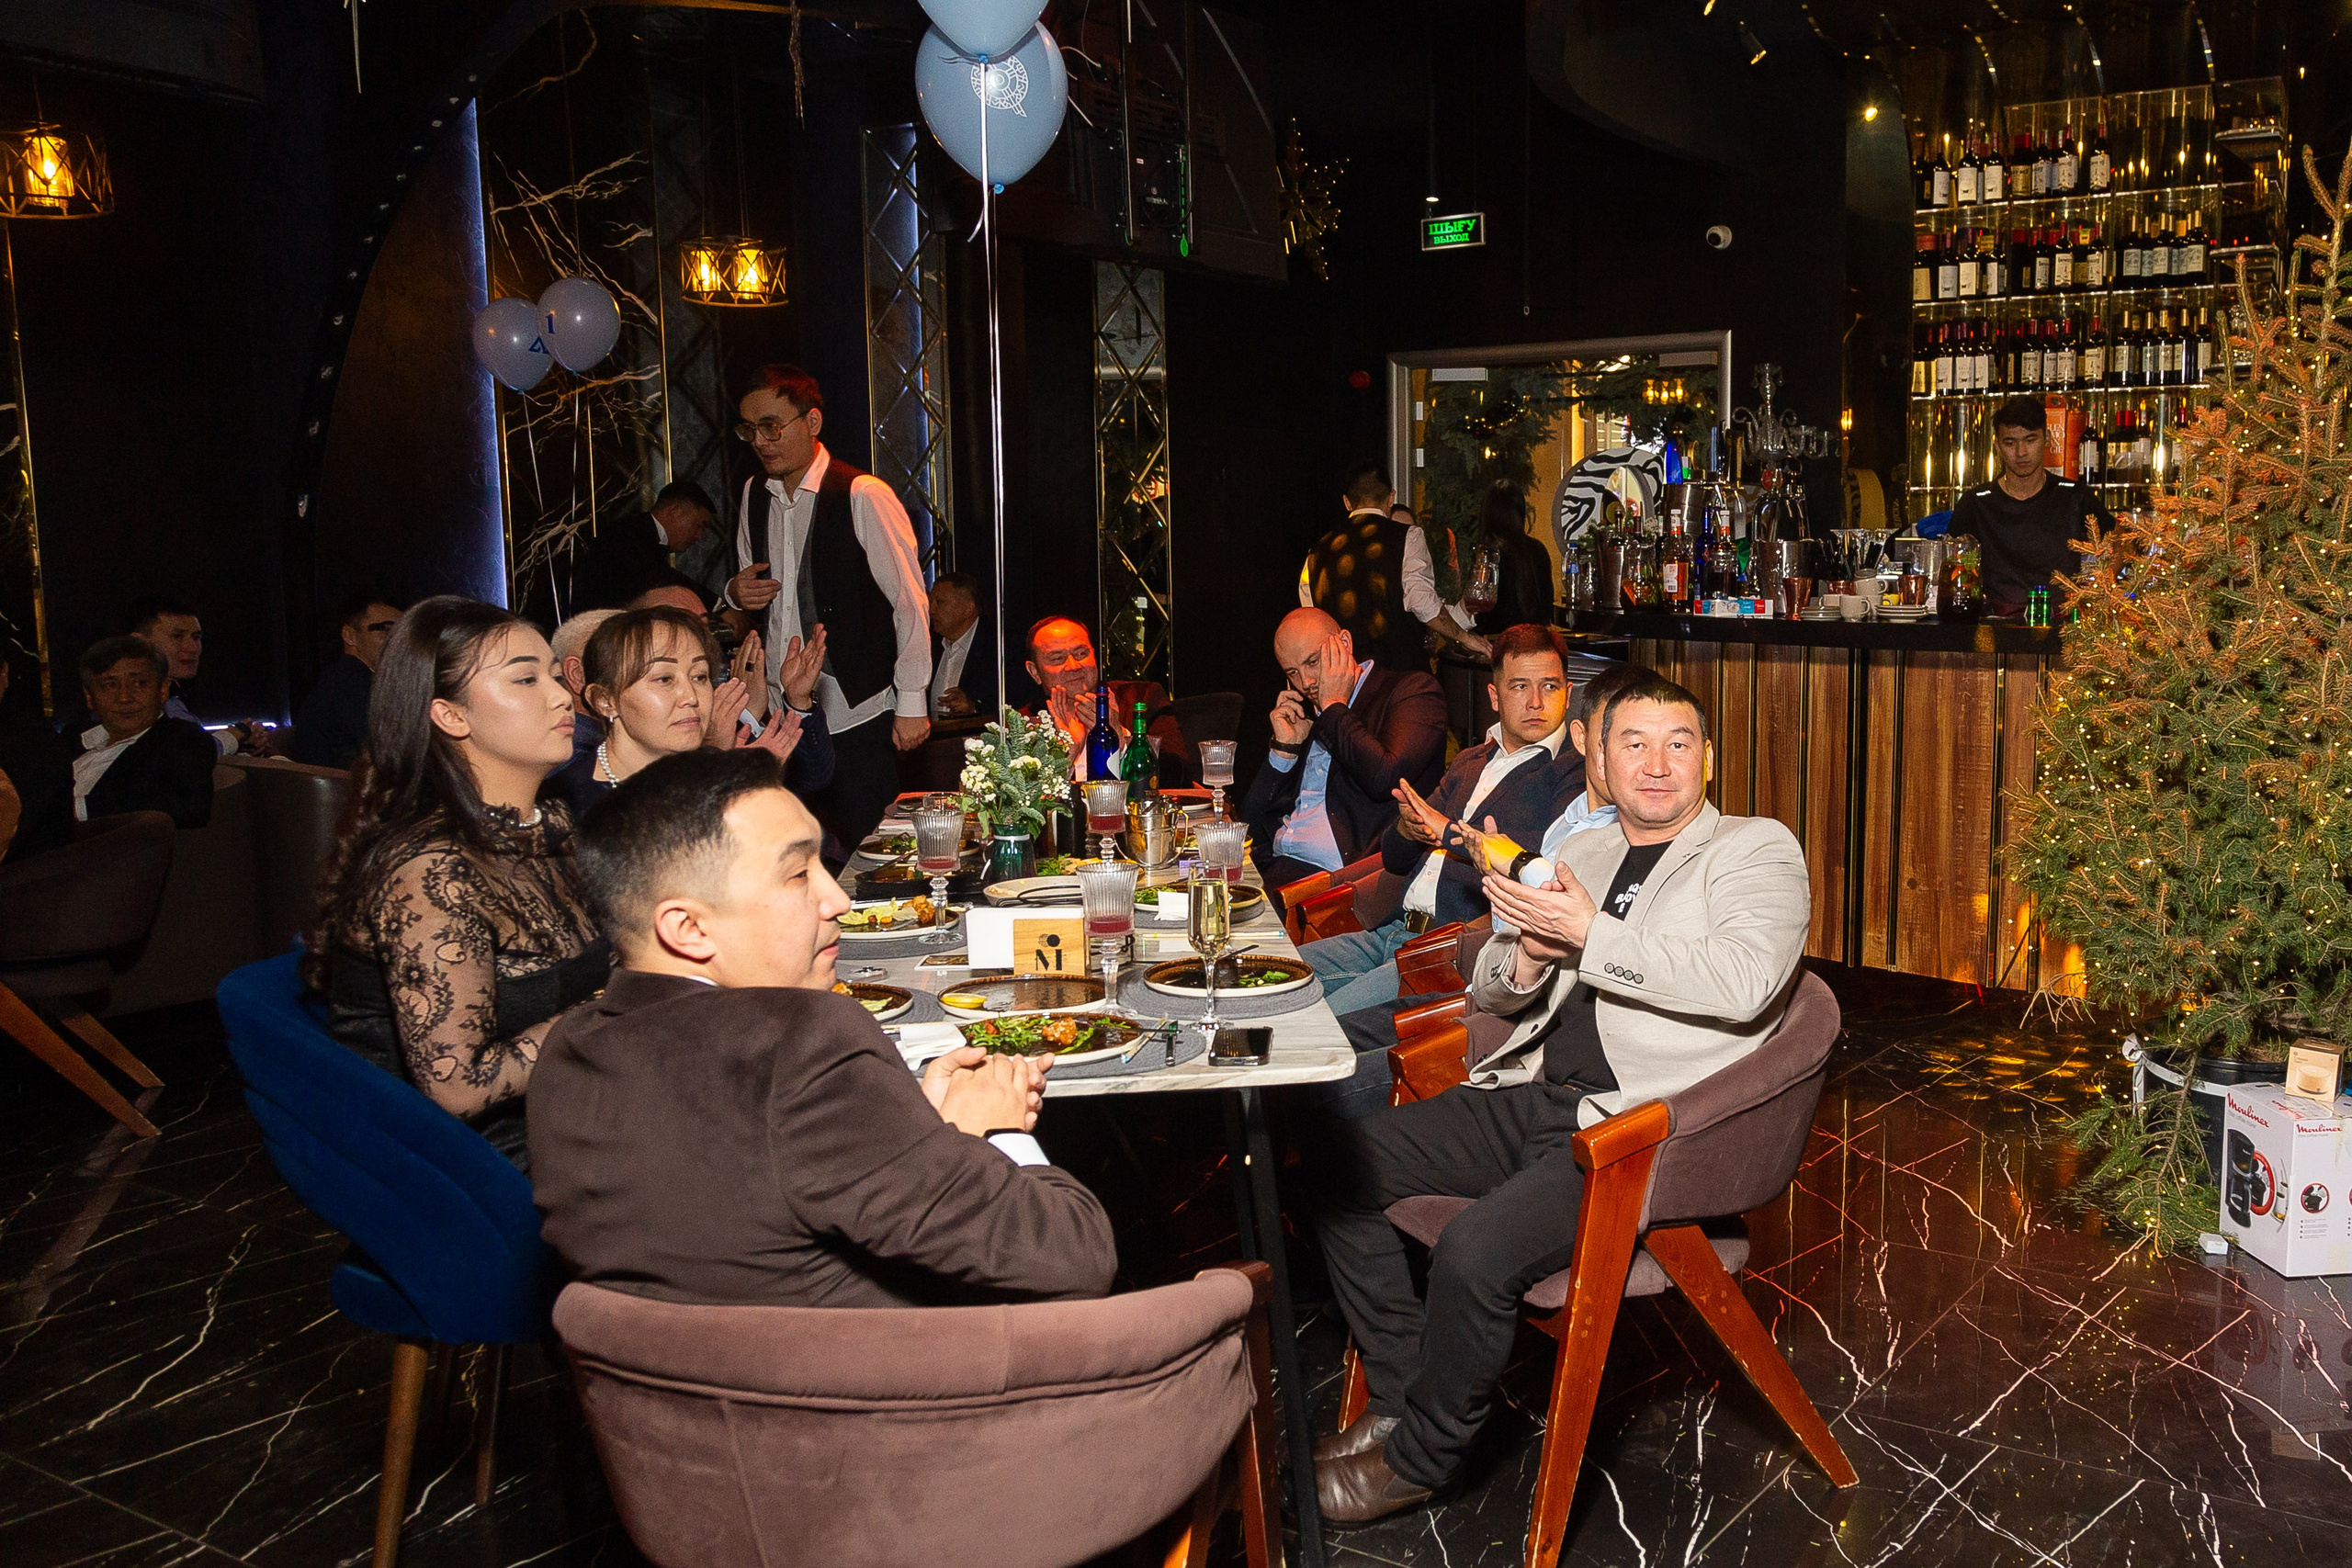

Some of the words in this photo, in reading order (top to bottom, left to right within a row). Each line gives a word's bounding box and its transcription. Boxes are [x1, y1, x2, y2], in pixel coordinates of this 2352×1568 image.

[1433, 232, 1469, 244] ВЫХОД
[2227, 1092, 2269, 1128] Moulinex
[2296, 1123, 2343, 1134] Moulinex
